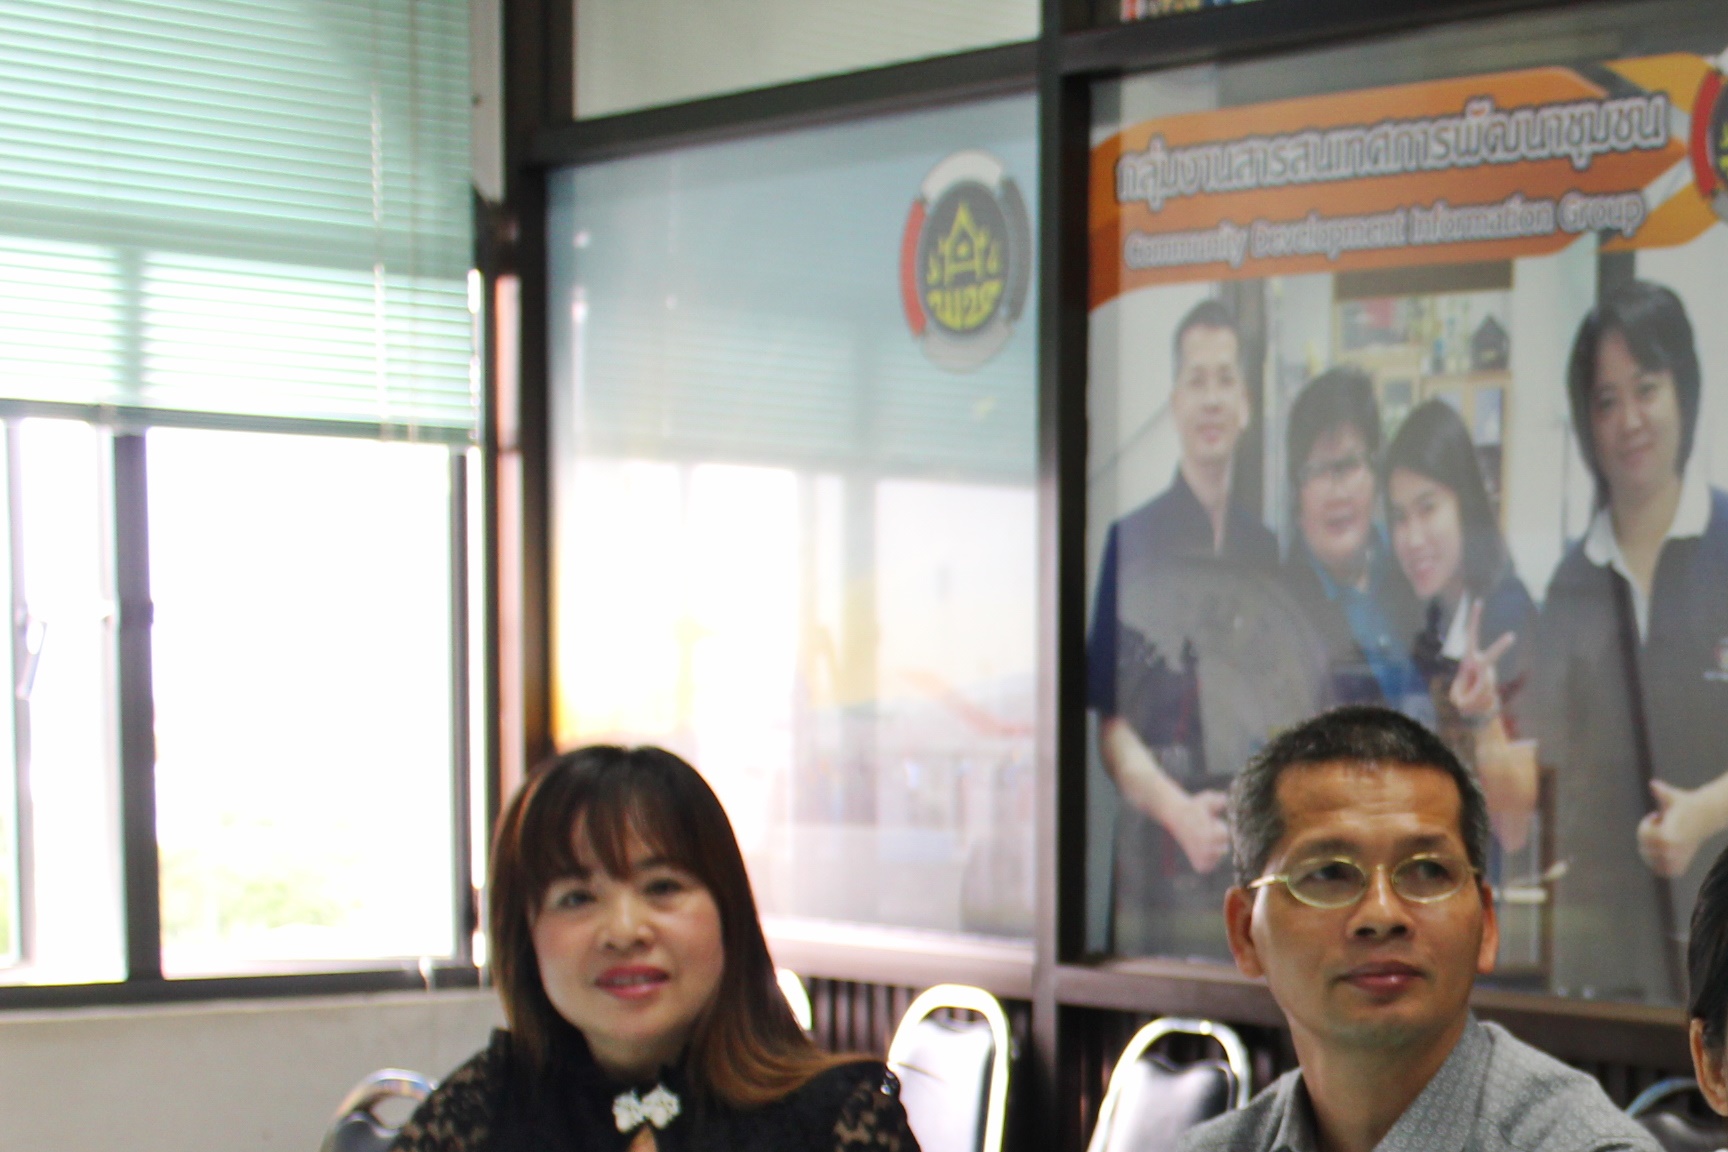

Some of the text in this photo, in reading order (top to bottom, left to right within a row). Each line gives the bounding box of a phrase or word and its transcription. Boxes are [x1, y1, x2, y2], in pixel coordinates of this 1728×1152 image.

[1117, 94, 1670, 211] กลุ่มงานสารสนเทศการพัฒนาชุมชน
[1125, 191, 1645, 269] Community Development Information Group
